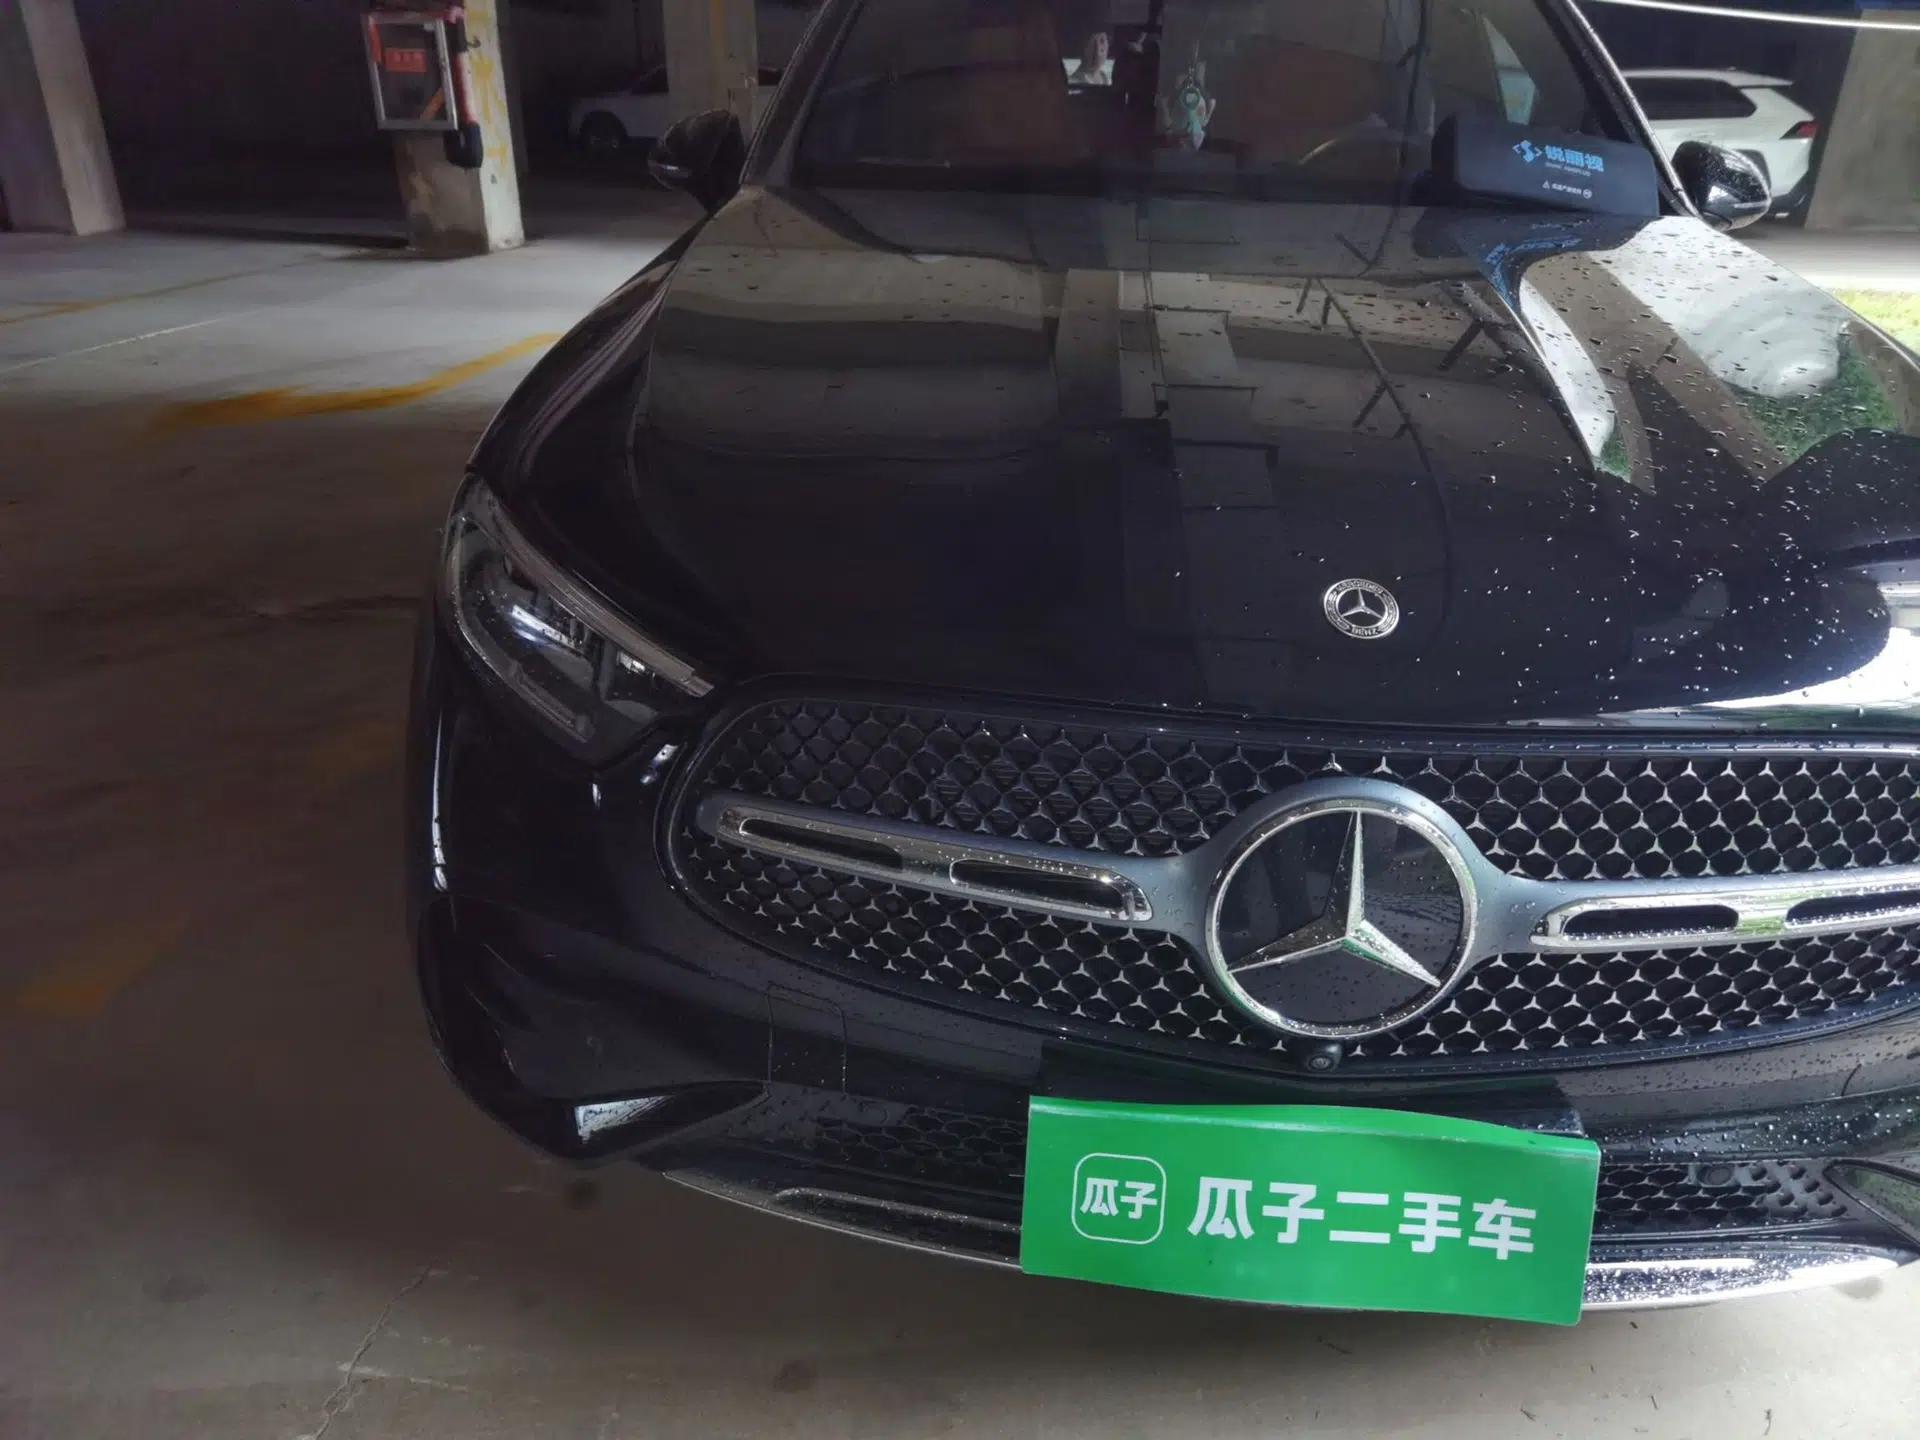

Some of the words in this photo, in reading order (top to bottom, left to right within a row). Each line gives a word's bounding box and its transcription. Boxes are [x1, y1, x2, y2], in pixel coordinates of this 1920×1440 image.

[1080, 1177, 1157, 1220] 瓜子
[1188, 1176, 1537, 1260] 瓜子二手车
